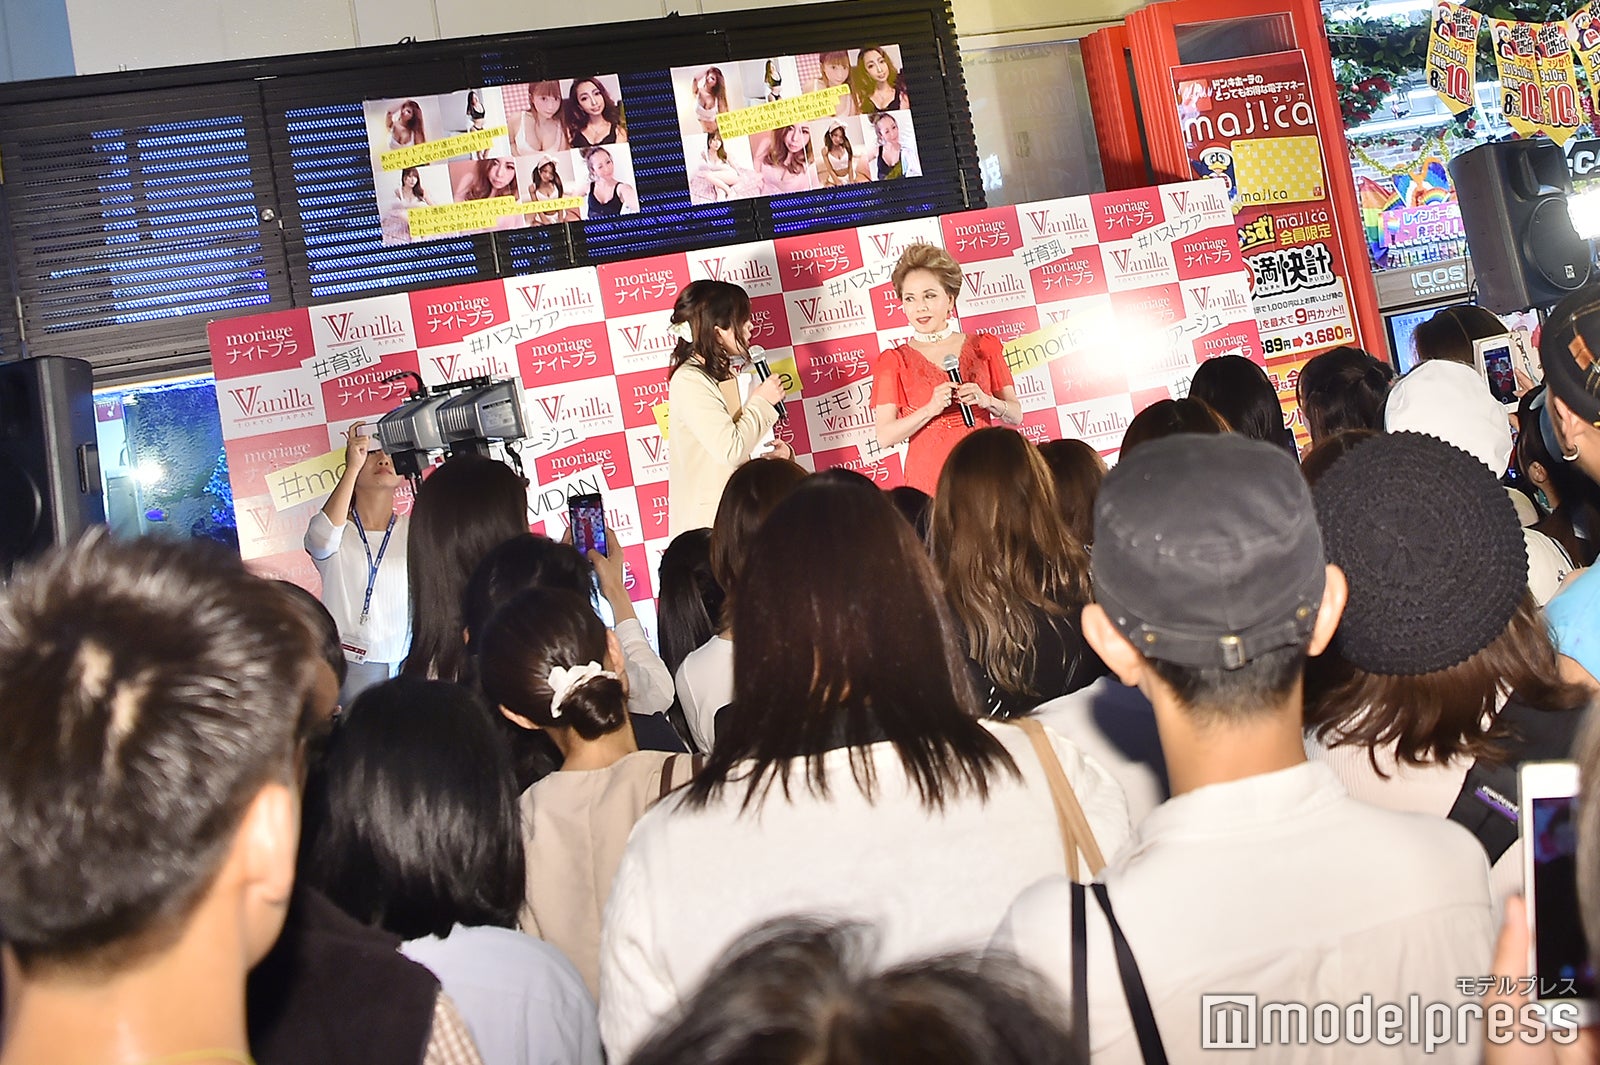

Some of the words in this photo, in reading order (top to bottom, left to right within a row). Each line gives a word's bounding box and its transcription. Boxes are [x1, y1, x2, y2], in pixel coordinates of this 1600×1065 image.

[1545, 82, 1580, 127] 10%
[1103, 198, 1150, 217] moriage
[1167, 190, 1225, 216] Vanilla
[1403, 206, 1461, 224] レインボー
[955, 217, 1006, 237] moriage
[1025, 209, 1089, 236] Vanilla
[1104, 211, 1155, 231] ナイトブラ
[1137, 213, 1202, 250] #バストケア
[955, 232, 1010, 253] ナイトブラ
[1183, 235, 1228, 254] moriage
[1280, 223, 1332, 246] 会員限定
[790, 241, 846, 262] moriage
[1021, 238, 1067, 268] #育乳
[1109, 248, 1169, 274] Vanilla
[1184, 250, 1233, 269] ナイトブラ
[614, 267, 674, 289] moriage
[791, 256, 850, 279] ナイトブラ
[1041, 257, 1089, 276] moriage
[1247, 246, 1328, 288] 満快計
[1411, 264, 1468, 290] IQOS
[962, 269, 1025, 298] Vanilla
[1042, 269, 1095, 291] ナイトブラ
[516, 283, 592, 312] Vanilla
[614, 280, 678, 305] ナイトブラ
[1189, 286, 1247, 311] Vanilla
[1254, 291, 1344, 315] 示で1,000円以上お買い上げ時の
[426, 295, 490, 317] moriage
[793, 297, 865, 329] Vanilla
[321, 312, 404, 342] Vanilla
[427, 311, 495, 334] ナイトブラ
[469, 310, 560, 355] #バストケア
[1169, 314, 1223, 346] アージュ
[225, 324, 294, 347] moriage
[376, 337, 405, 346] APAN
[532, 335, 593, 357] moriage
[1203, 331, 1249, 350] moriage
[1305, 325, 1352, 346] 3,680円
[226, 340, 299, 365] ナイトブラ
[311, 345, 374, 380] #育乳
[533, 350, 598, 375] ナイトブラ
[810, 347, 866, 369] moriage
[430, 355, 509, 383] Vanilla
[811, 361, 871, 385] ナイトブラ
[338, 381, 407, 407] ナイトブラ
[633, 376, 669, 397] mori
[1015, 374, 1045, 396] nilla
[227, 386, 315, 417] Vanilla
[536, 395, 613, 424] Vanilla
[823, 406, 877, 431] Vanill
[1066, 409, 1129, 437] Vanilla
[244, 441, 312, 466] moriage
[551, 448, 612, 470] moriage
